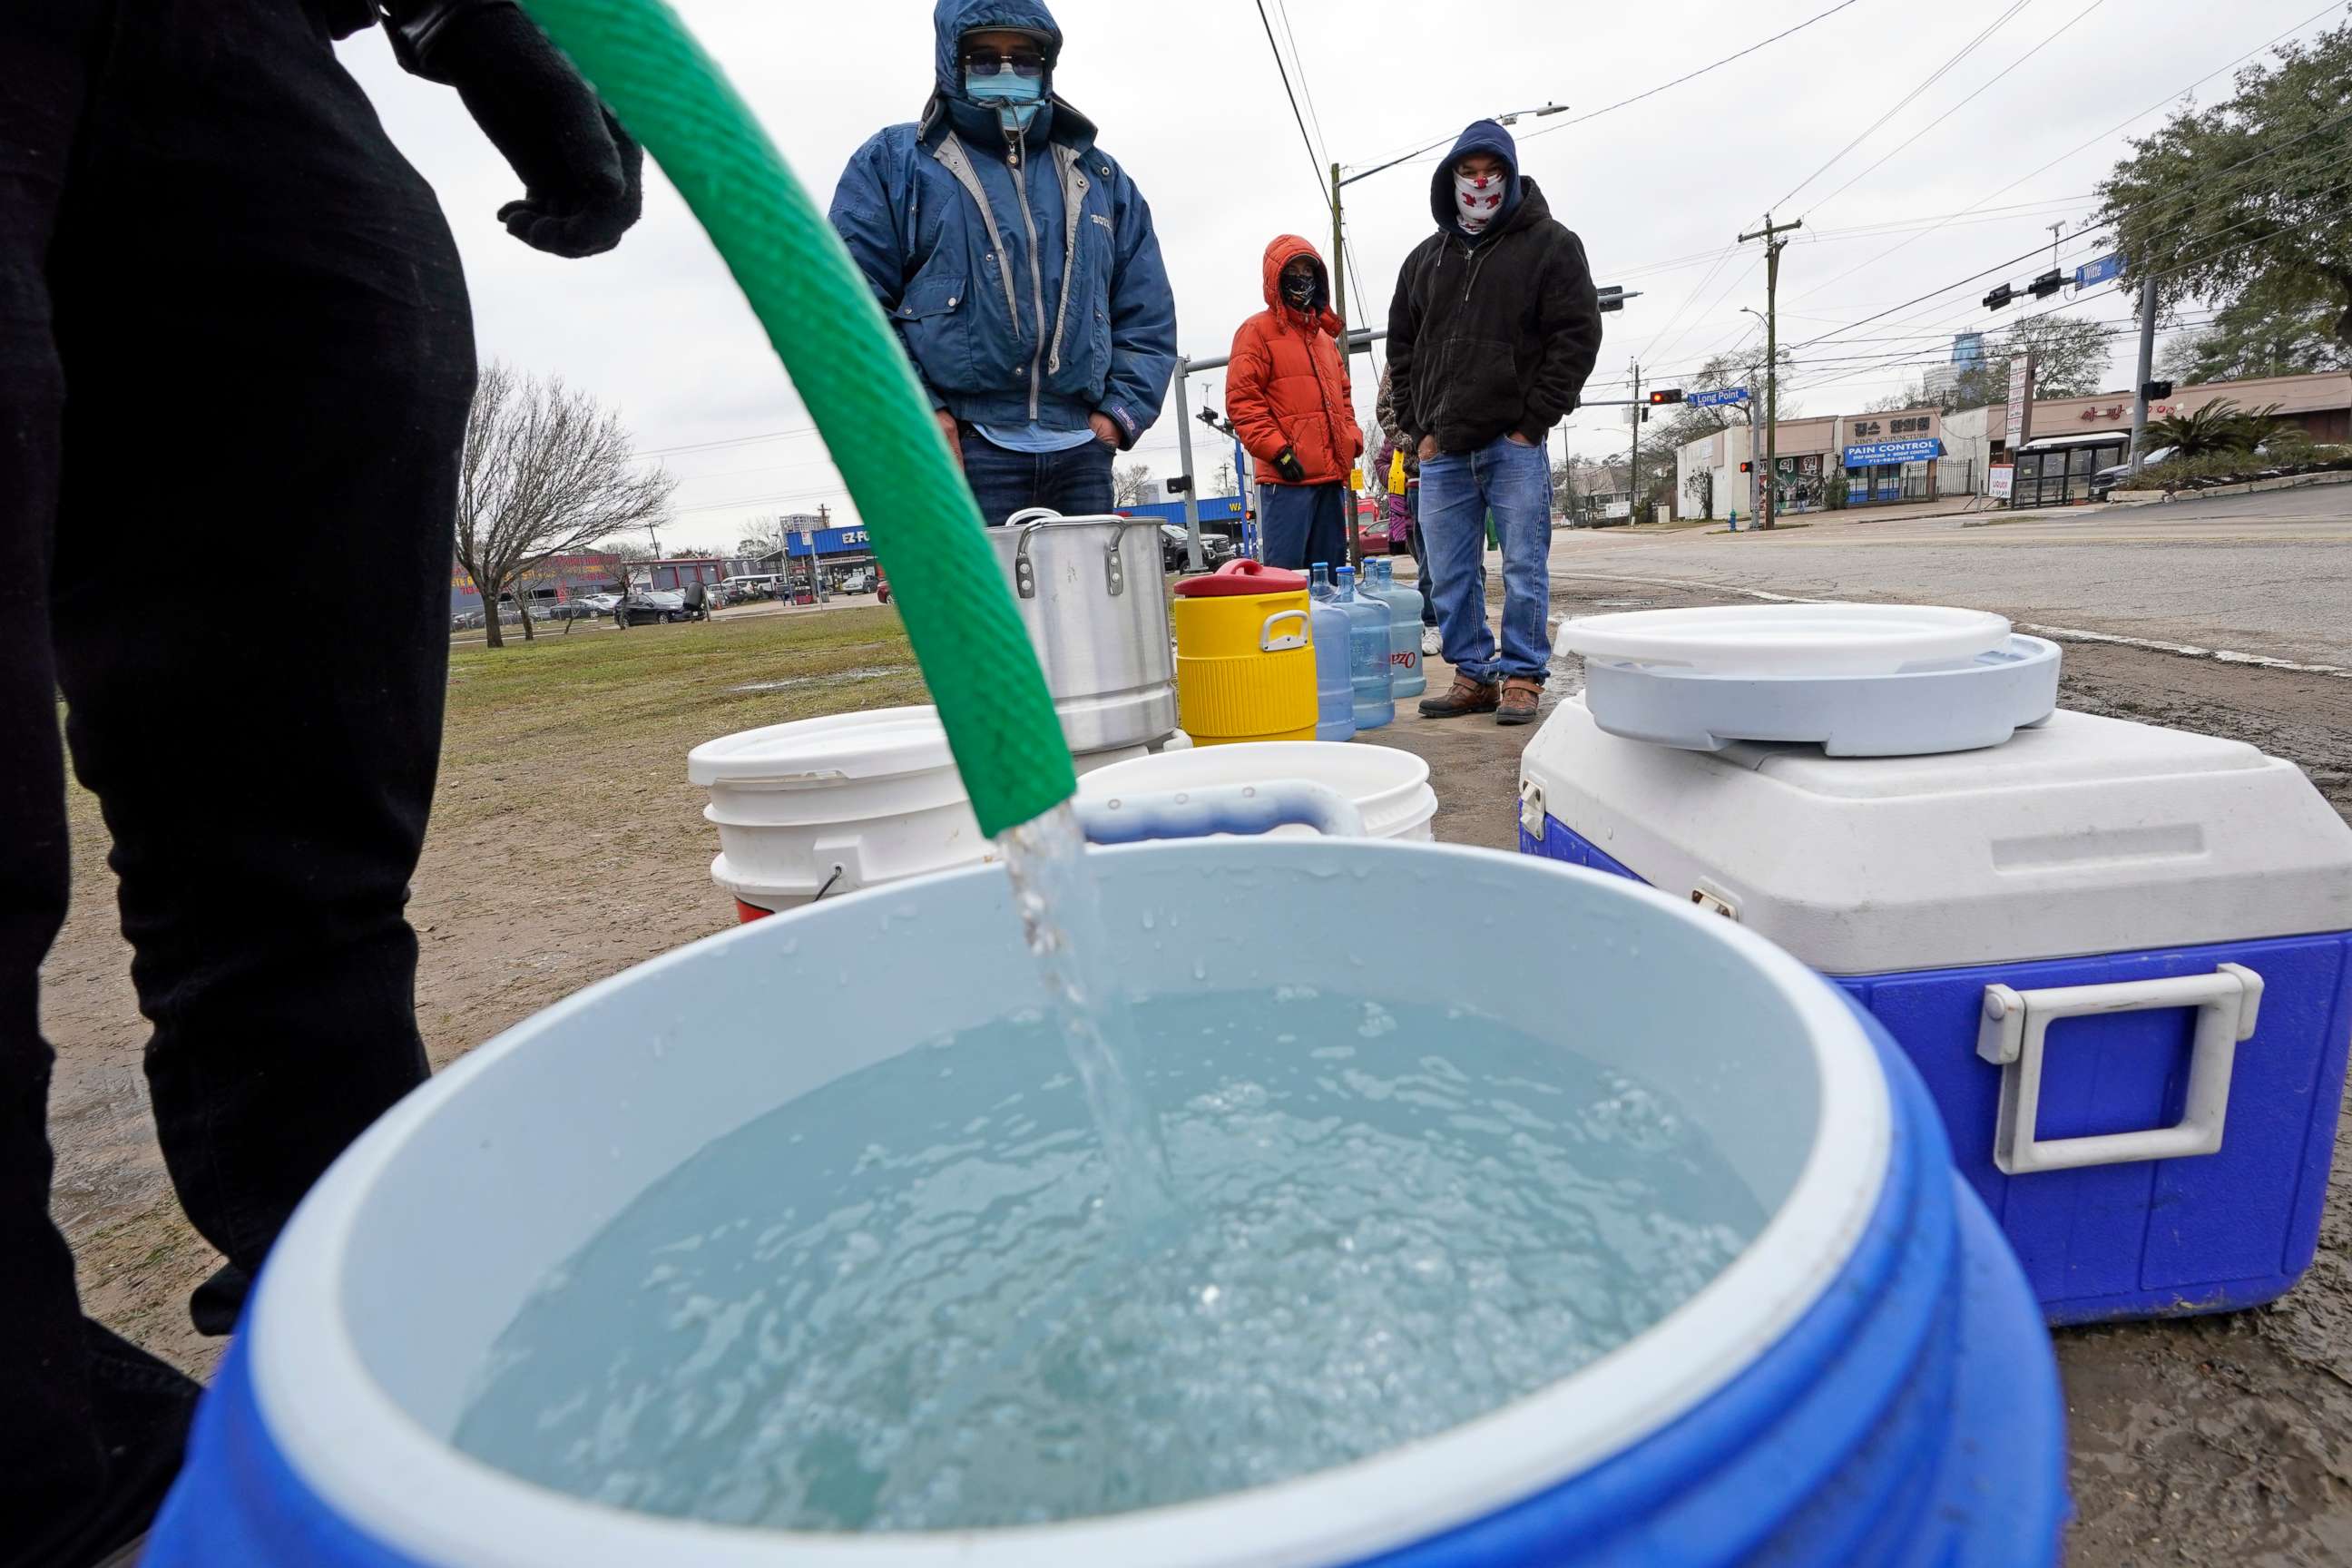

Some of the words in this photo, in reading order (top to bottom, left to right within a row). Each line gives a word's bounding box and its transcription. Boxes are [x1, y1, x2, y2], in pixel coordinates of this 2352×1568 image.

[2083, 263, 2102, 279] Witte
[1698, 393, 1717, 404] Long
[1719, 390, 1740, 401] Point
[1877, 433, 1928, 444] ACUPUNCTURE
[1848, 446, 1876, 455] PAIN
[1879, 441, 1935, 453] CONTROL
[1391, 652, 1416, 669] Oza
